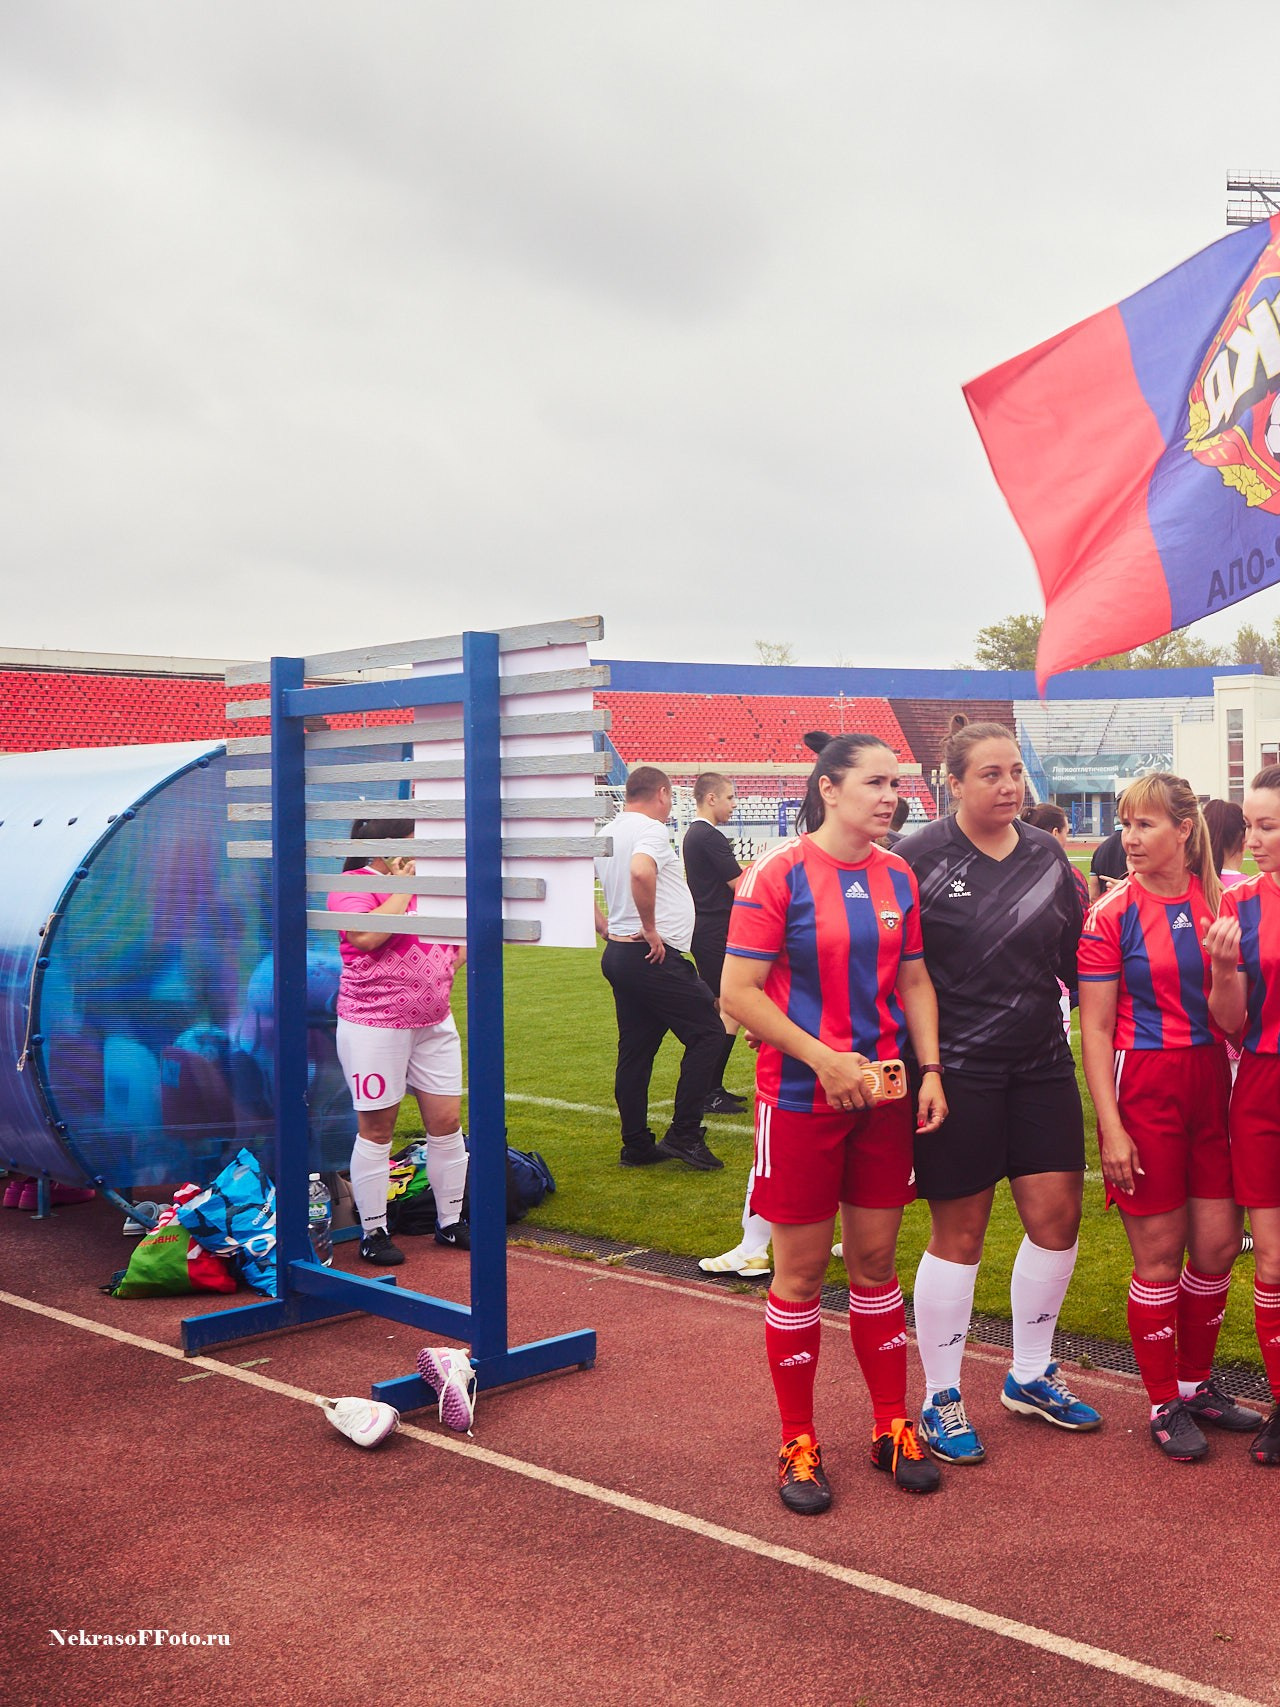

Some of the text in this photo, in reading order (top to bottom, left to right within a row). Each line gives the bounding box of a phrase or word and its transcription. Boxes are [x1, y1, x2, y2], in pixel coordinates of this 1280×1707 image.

[845, 891, 869, 899] adidas
[1172, 921, 1193, 930] adidas
[352, 1073, 386, 1100] 10
